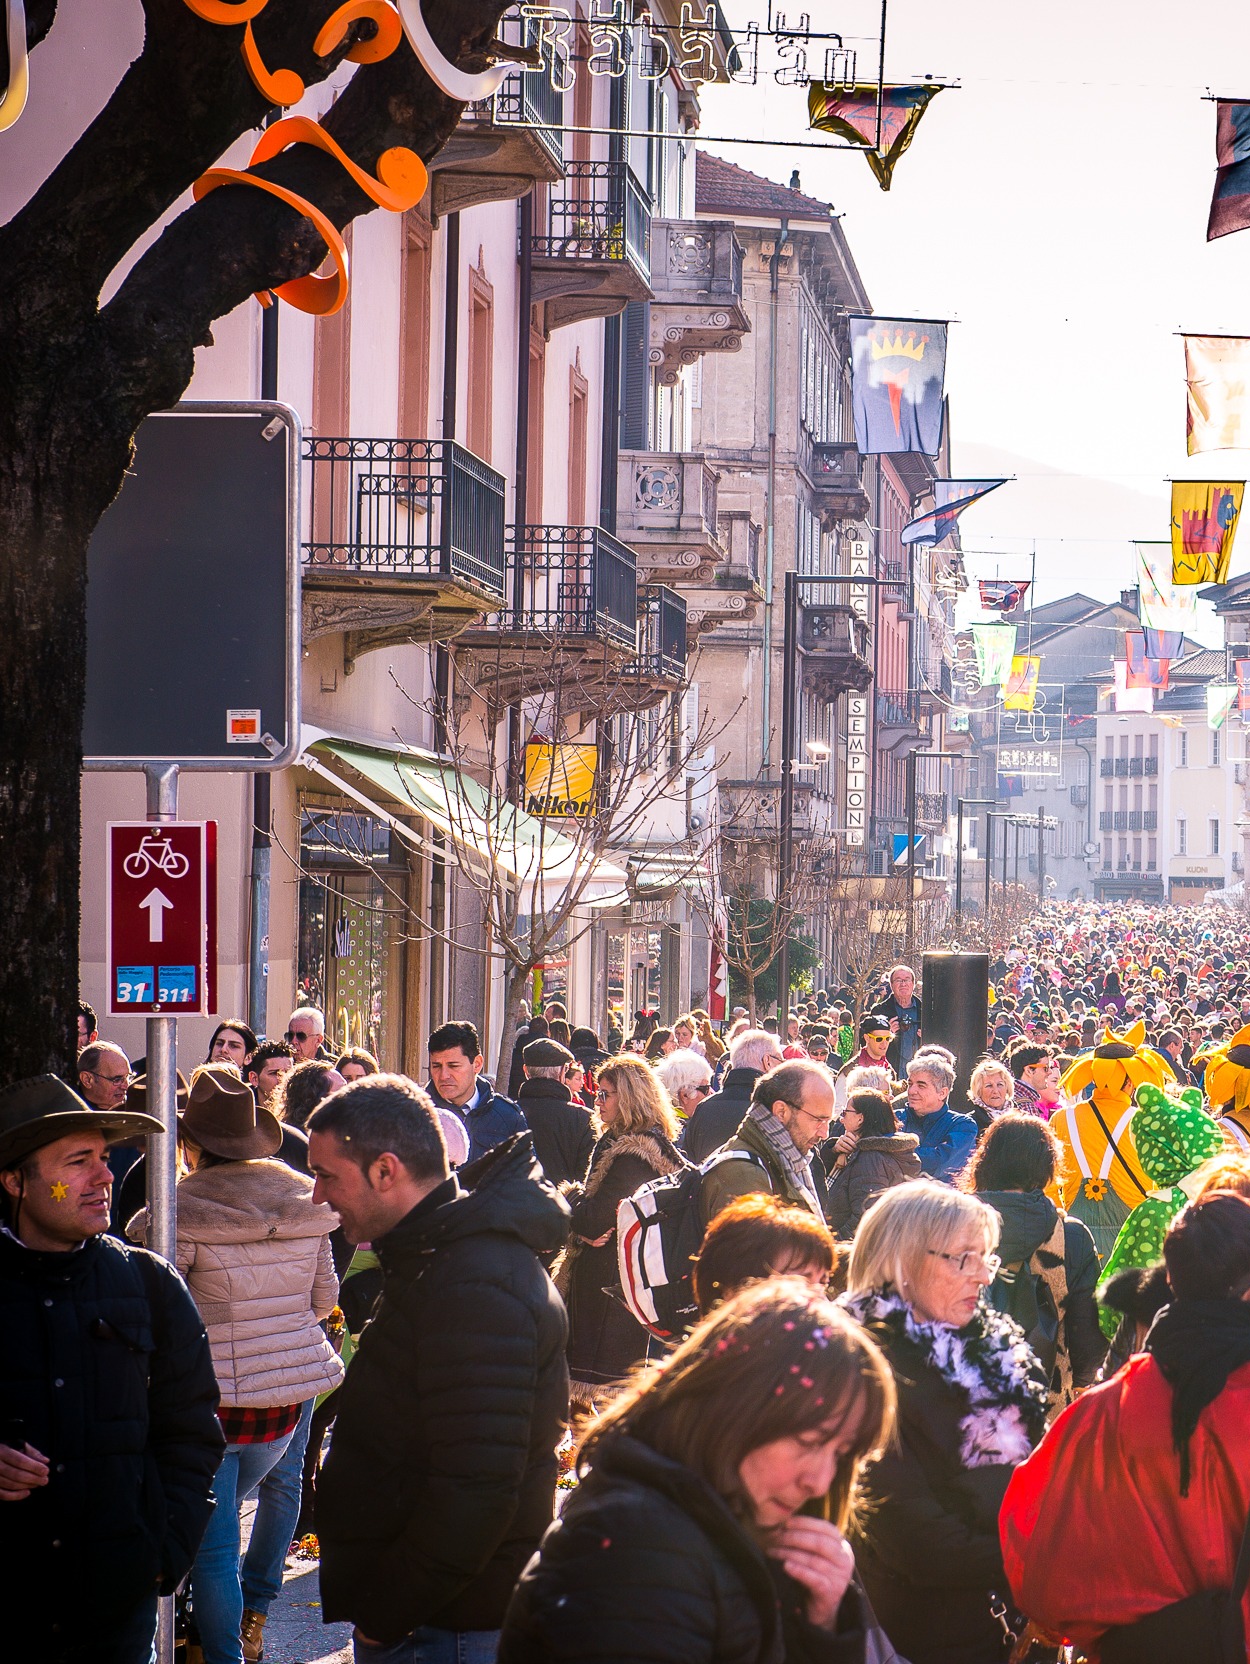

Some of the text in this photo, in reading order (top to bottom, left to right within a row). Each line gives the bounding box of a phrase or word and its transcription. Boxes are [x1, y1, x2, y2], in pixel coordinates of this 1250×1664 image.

[853, 543, 866, 613] BANC
[117, 983, 146, 1002] 31
[159, 988, 189, 1002] 311
